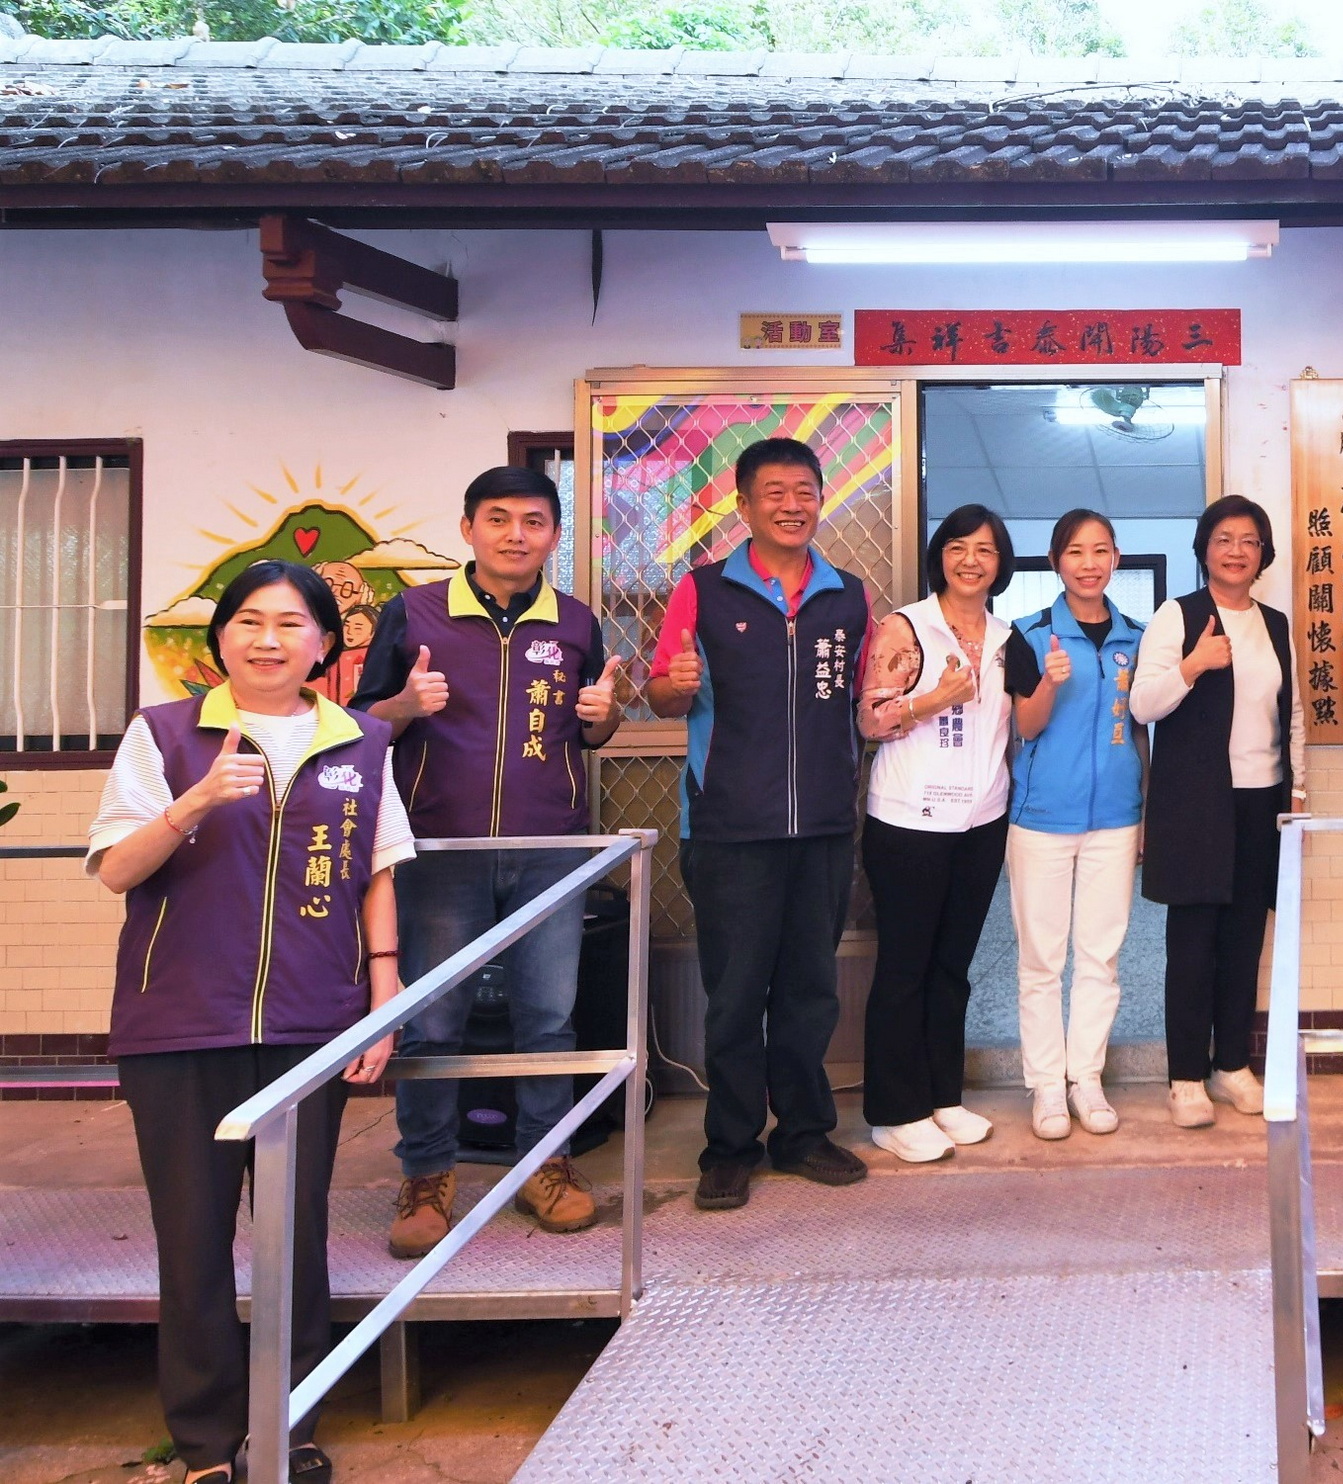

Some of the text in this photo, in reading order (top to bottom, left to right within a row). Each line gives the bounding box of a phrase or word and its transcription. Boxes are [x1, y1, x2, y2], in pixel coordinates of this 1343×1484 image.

[761, 320, 840, 343] 活動室
[1305, 507, 1338, 726] 照顧關懷據點
[553, 669, 567, 706] 秘書
[814, 638, 833, 700] 蕭益忠
[833, 629, 847, 689] 泰安村長
[522, 679, 552, 762] 蕭自成
[300, 823, 333, 919] 王蘭心
[338, 797, 358, 881] 社會處長
